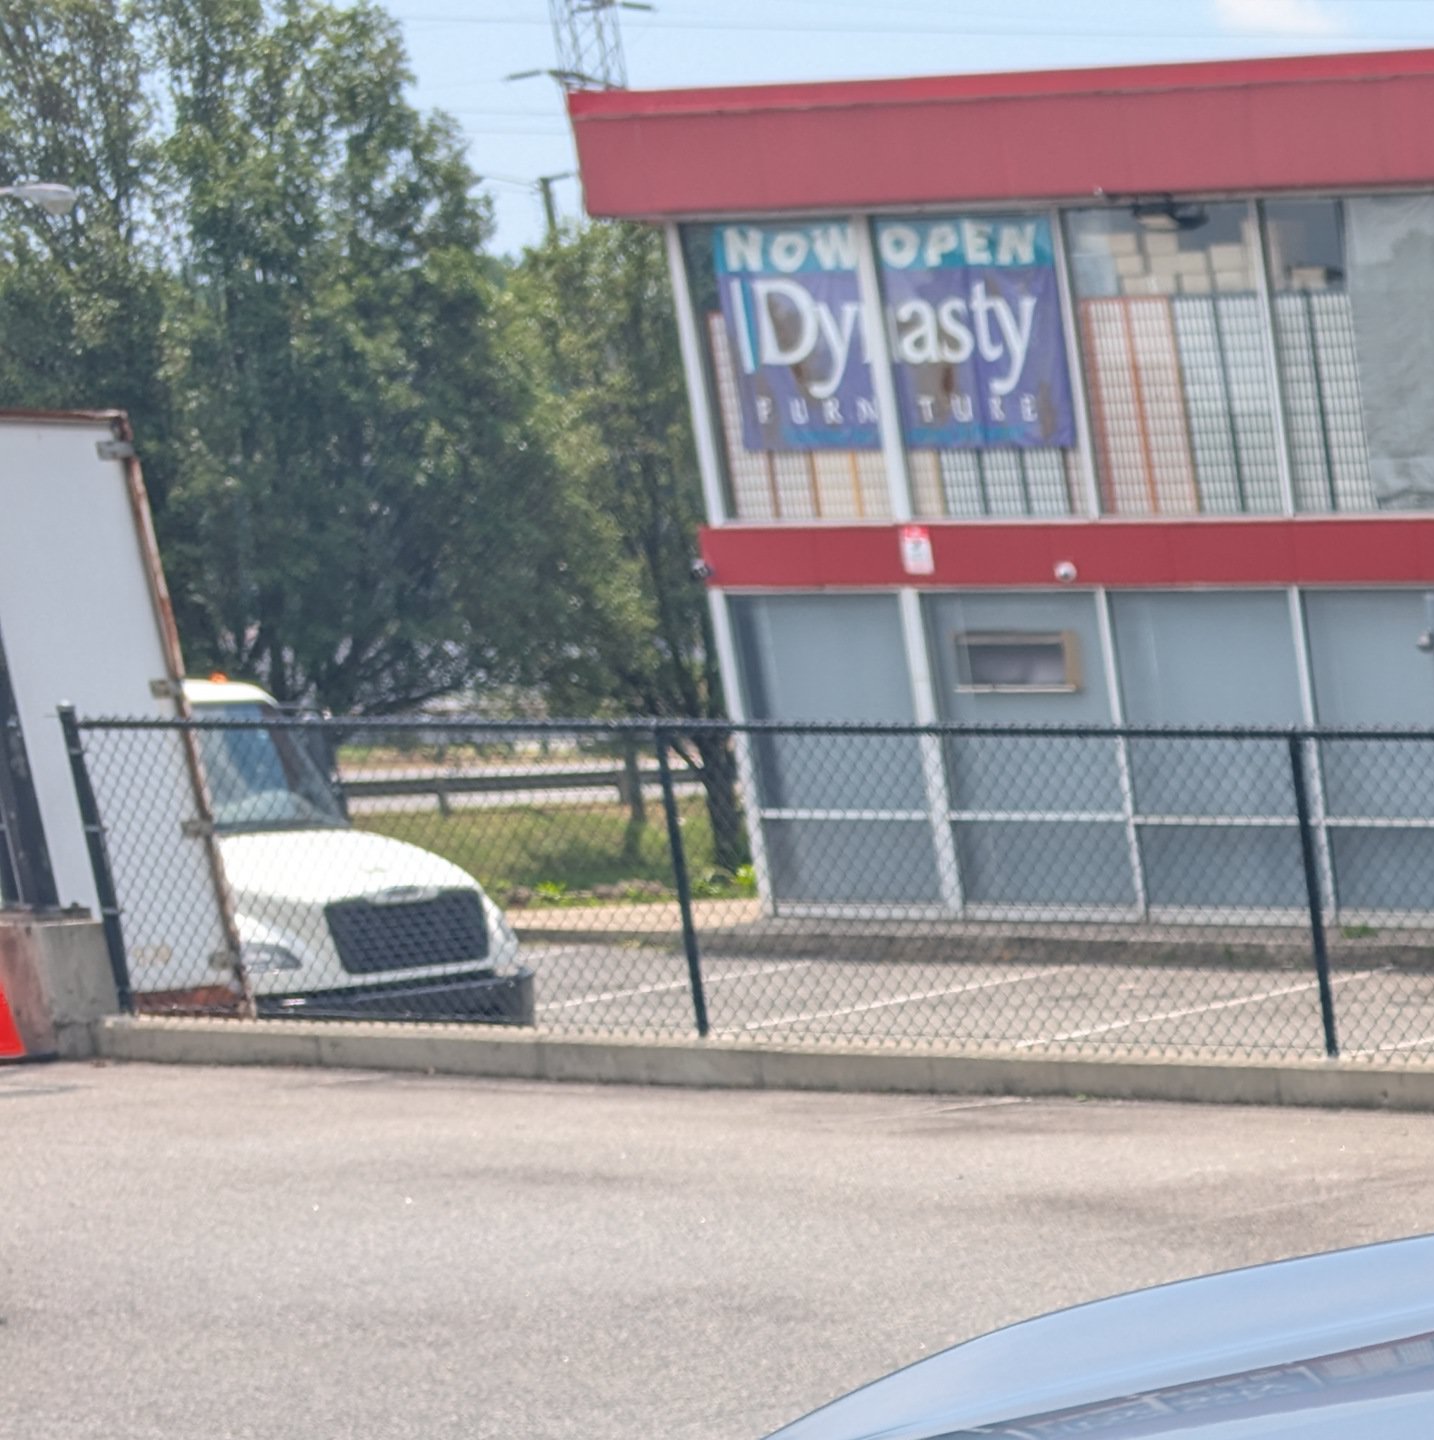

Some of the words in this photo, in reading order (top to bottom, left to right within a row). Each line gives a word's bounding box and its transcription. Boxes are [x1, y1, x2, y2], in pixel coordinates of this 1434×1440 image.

[722, 224, 860, 272] NOW
[878, 219, 1037, 269] OPEN
[755, 394, 1039, 427] FURNTURE
